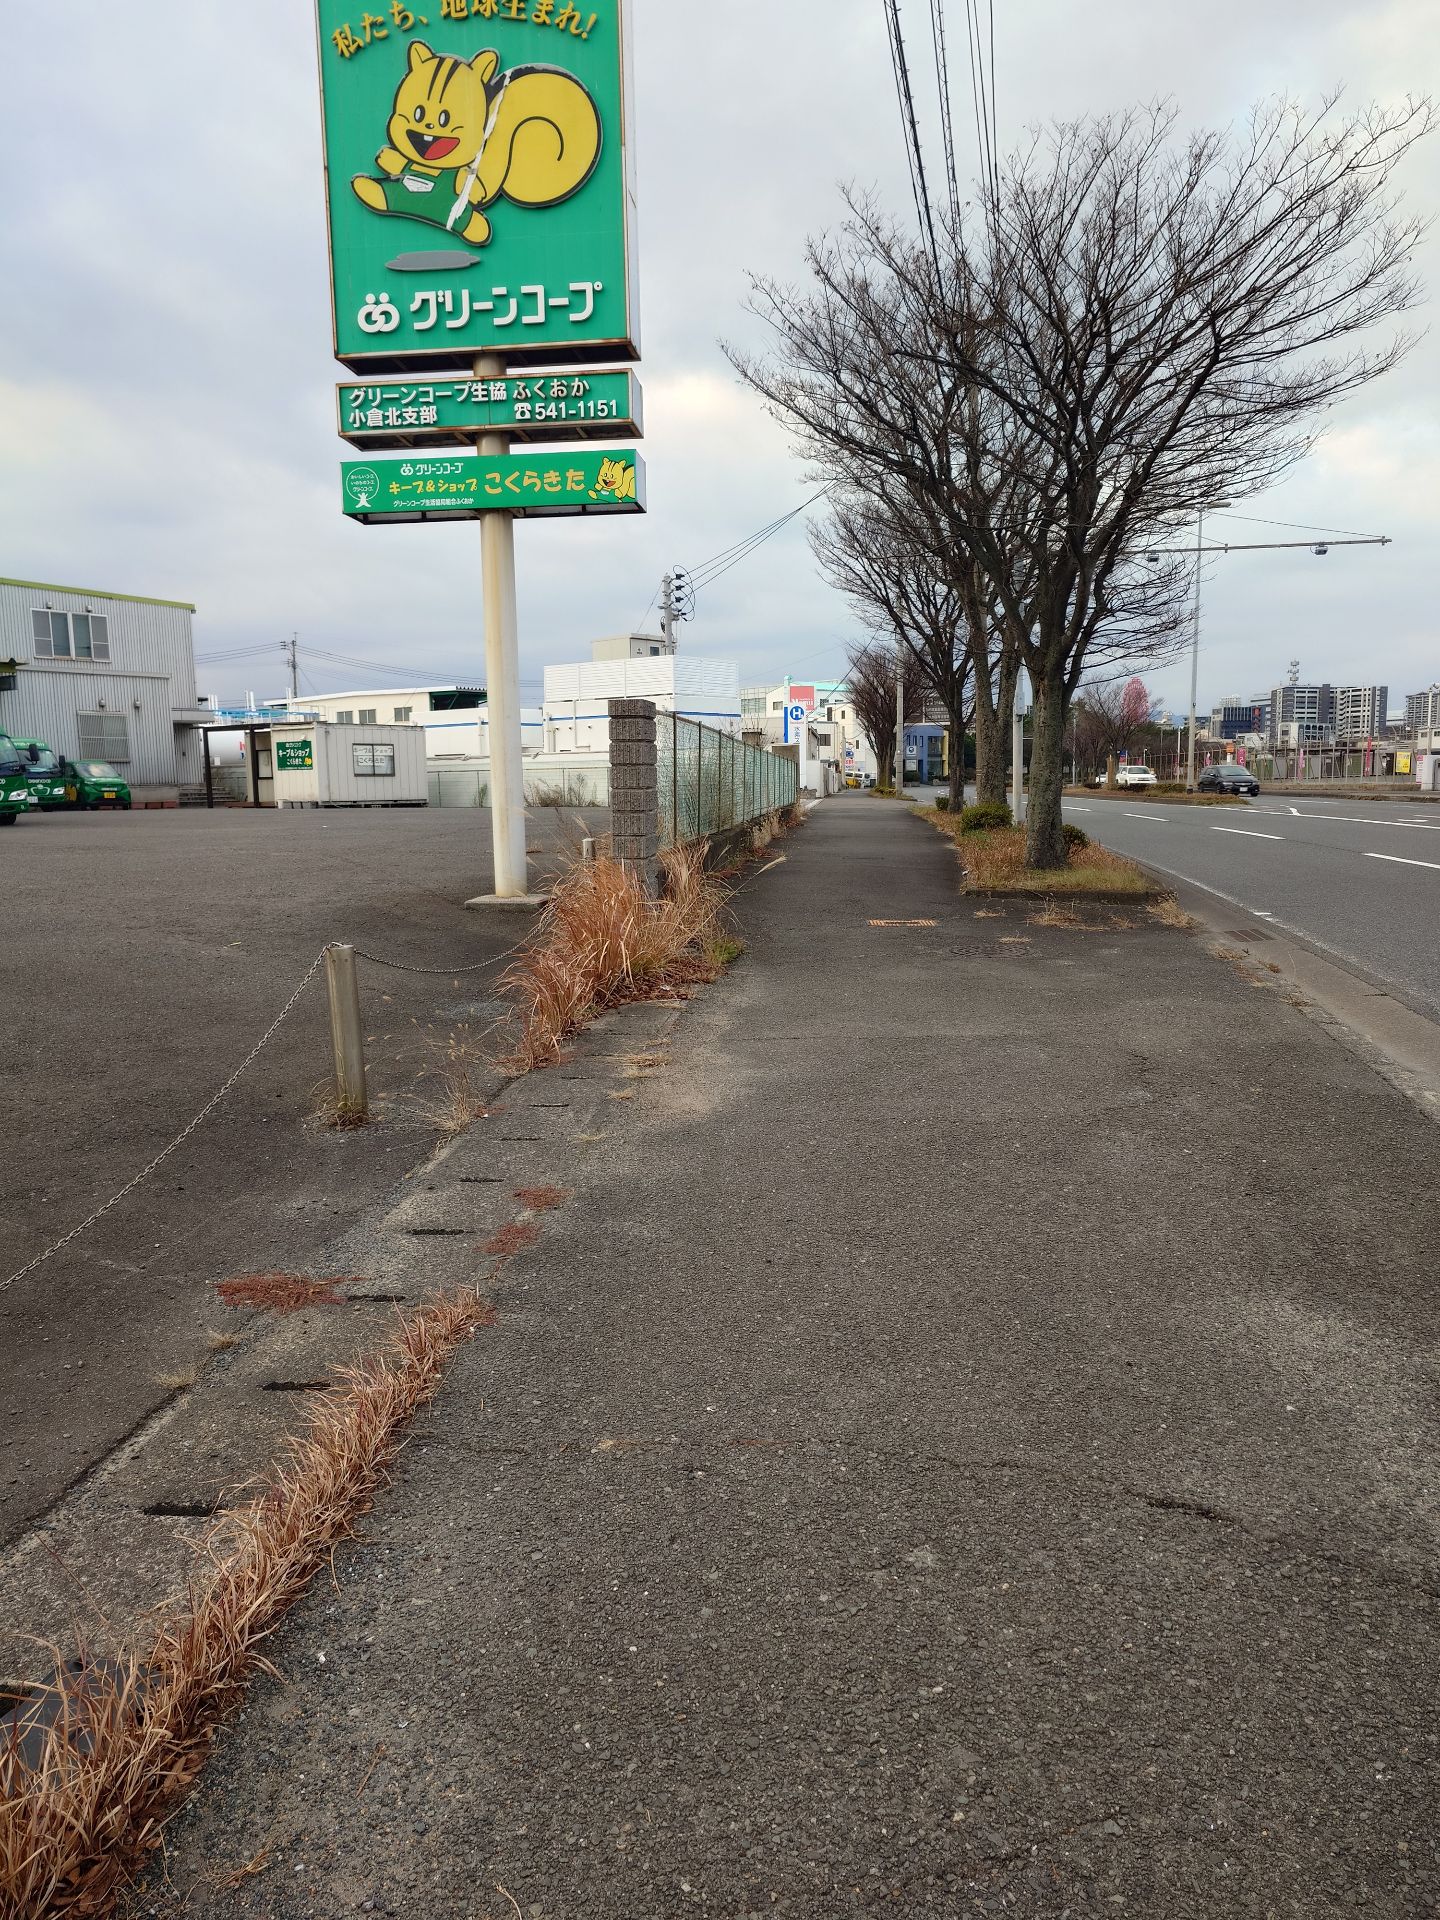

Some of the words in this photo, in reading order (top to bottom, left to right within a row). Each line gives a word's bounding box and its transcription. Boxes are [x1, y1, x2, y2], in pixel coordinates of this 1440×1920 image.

[409, 280, 603, 331] グリーンコープ
[348, 381, 508, 409] グリーンコープ生協
[512, 377, 591, 400] ふくおか
[348, 405, 439, 429] 小倉北支部
[535, 399, 618, 420] 541-1151
[415, 462, 464, 476] グリーンコープ
[484, 468, 586, 495] こくらきた
